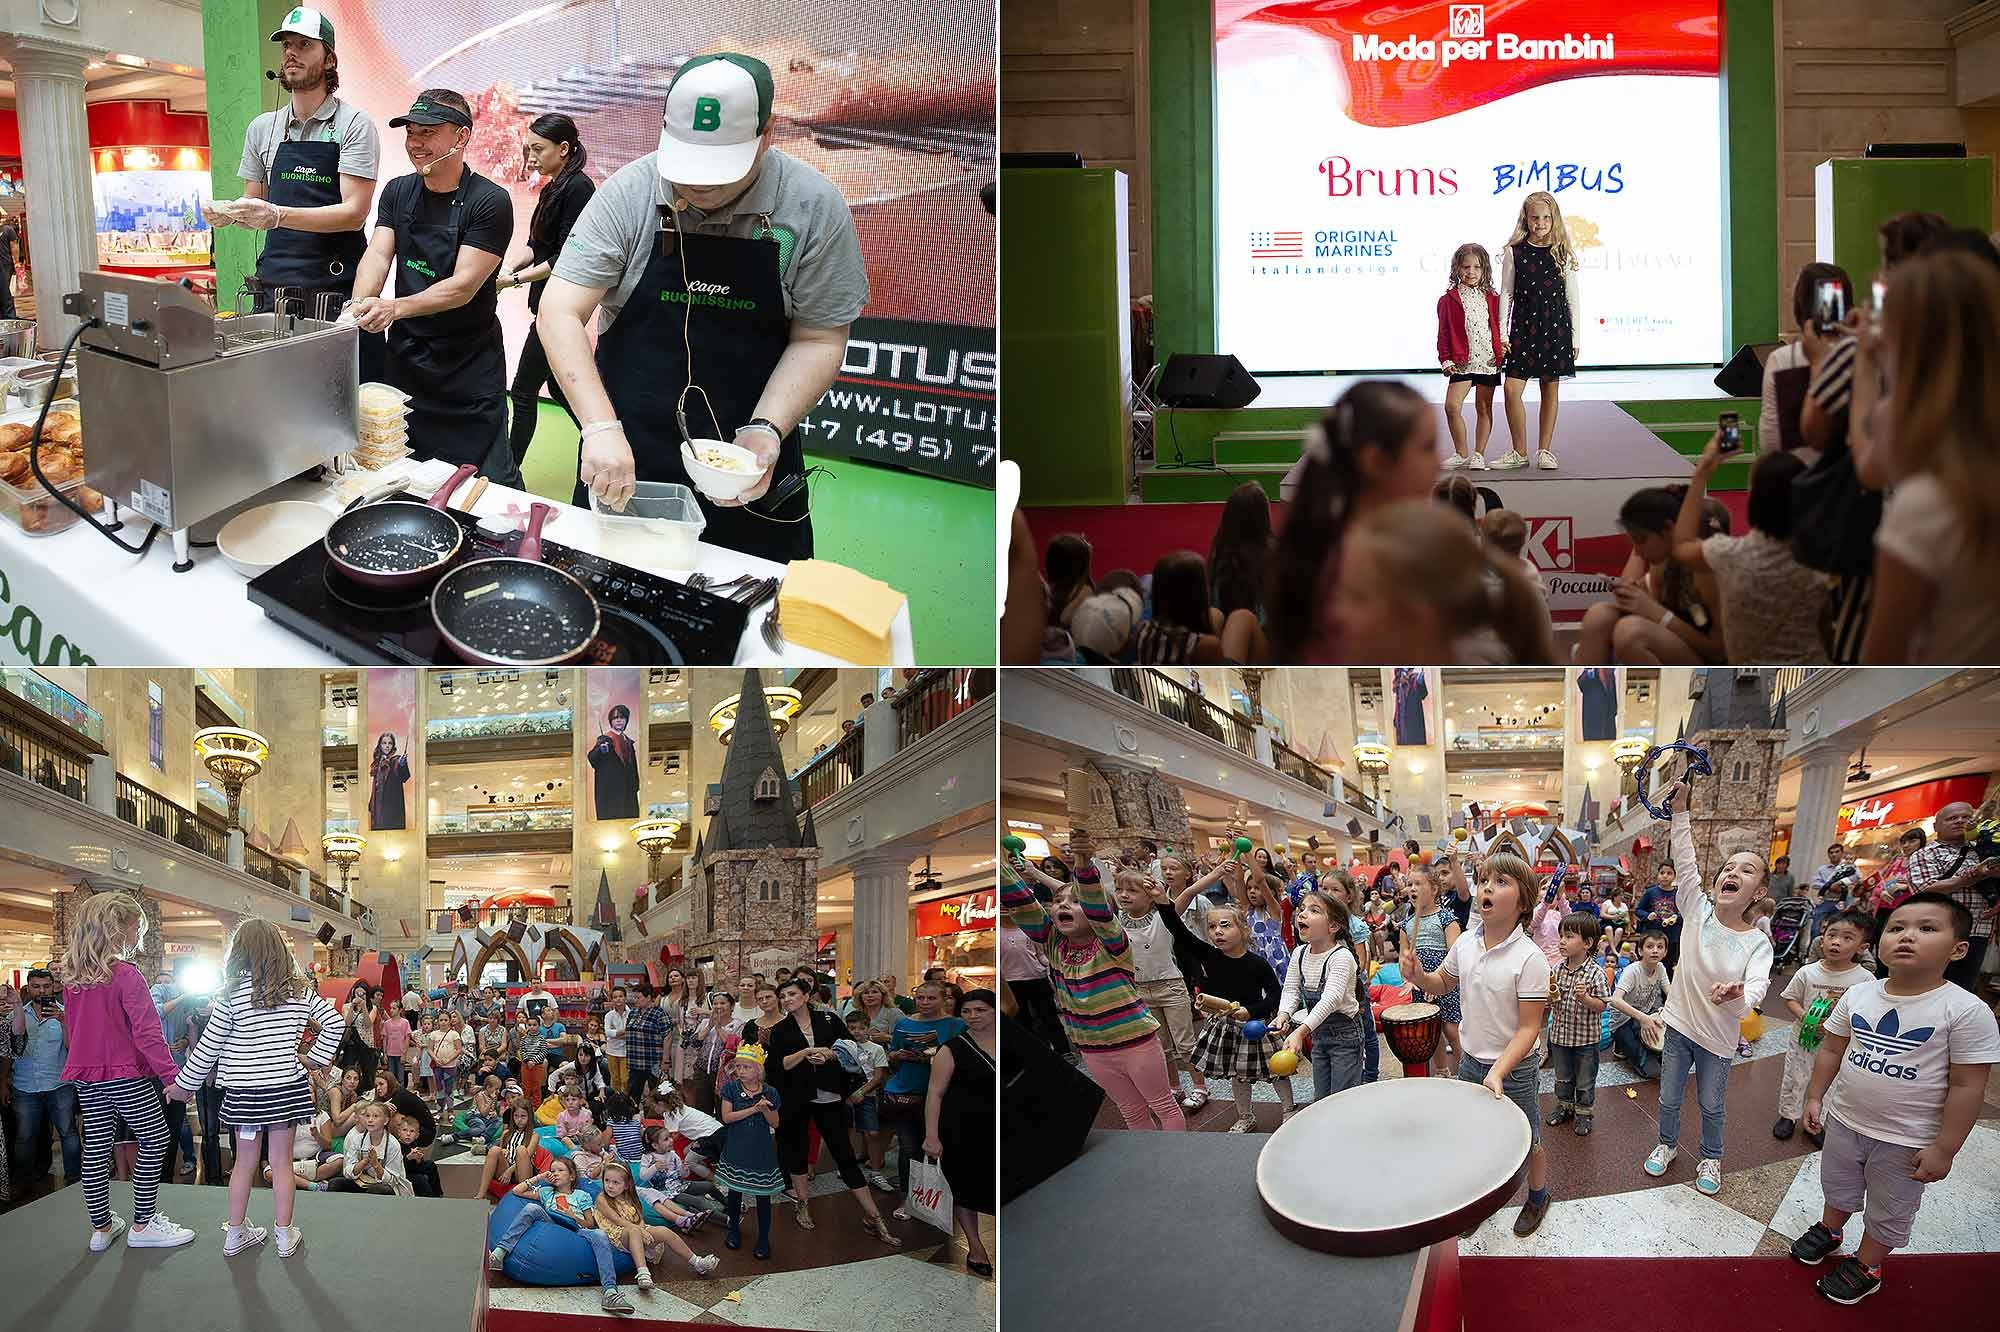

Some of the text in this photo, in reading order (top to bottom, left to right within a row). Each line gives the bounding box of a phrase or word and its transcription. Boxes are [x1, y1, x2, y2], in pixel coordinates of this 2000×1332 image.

[289, 9, 302, 24] B
[1352, 33, 1615, 68] Moda per Bambini
[693, 96, 721, 132] B
[280, 172, 332, 184] BUONISSIMO
[1318, 155, 1459, 197] Brums
[1314, 230, 1399, 243] ORIGINAL
[1315, 245, 1393, 257] MARINES
[660, 289, 756, 311] BUONISSIMO
[840, 339, 996, 391] OTUS
[816, 388, 996, 432] WW.LOTU
[798, 415, 841, 440] +7
[855, 424, 953, 461] (495)
[1520, 519, 1572, 569] K!
